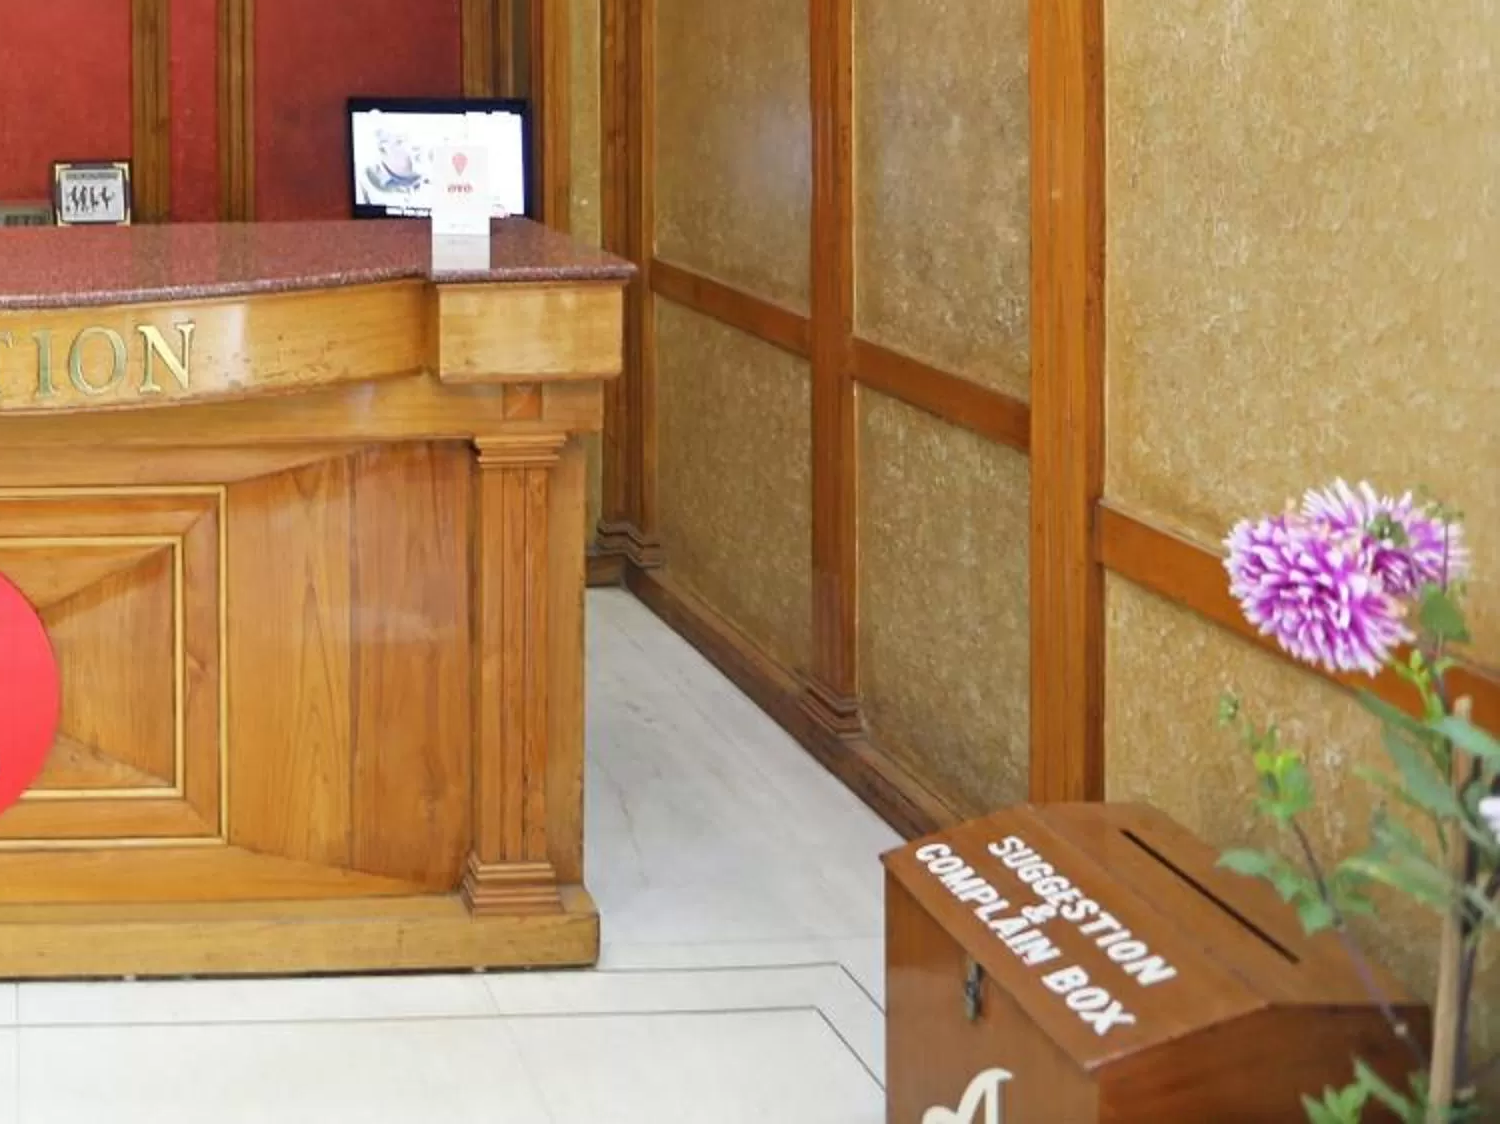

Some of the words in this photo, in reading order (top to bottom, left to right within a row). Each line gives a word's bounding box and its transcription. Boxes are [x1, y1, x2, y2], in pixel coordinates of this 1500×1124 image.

[915, 842, 1062, 966] COMPLAIN
[1040, 964, 1137, 1036] BOX
[987, 835, 1178, 986] SUGGESTION
[1021, 903, 1057, 925] &
